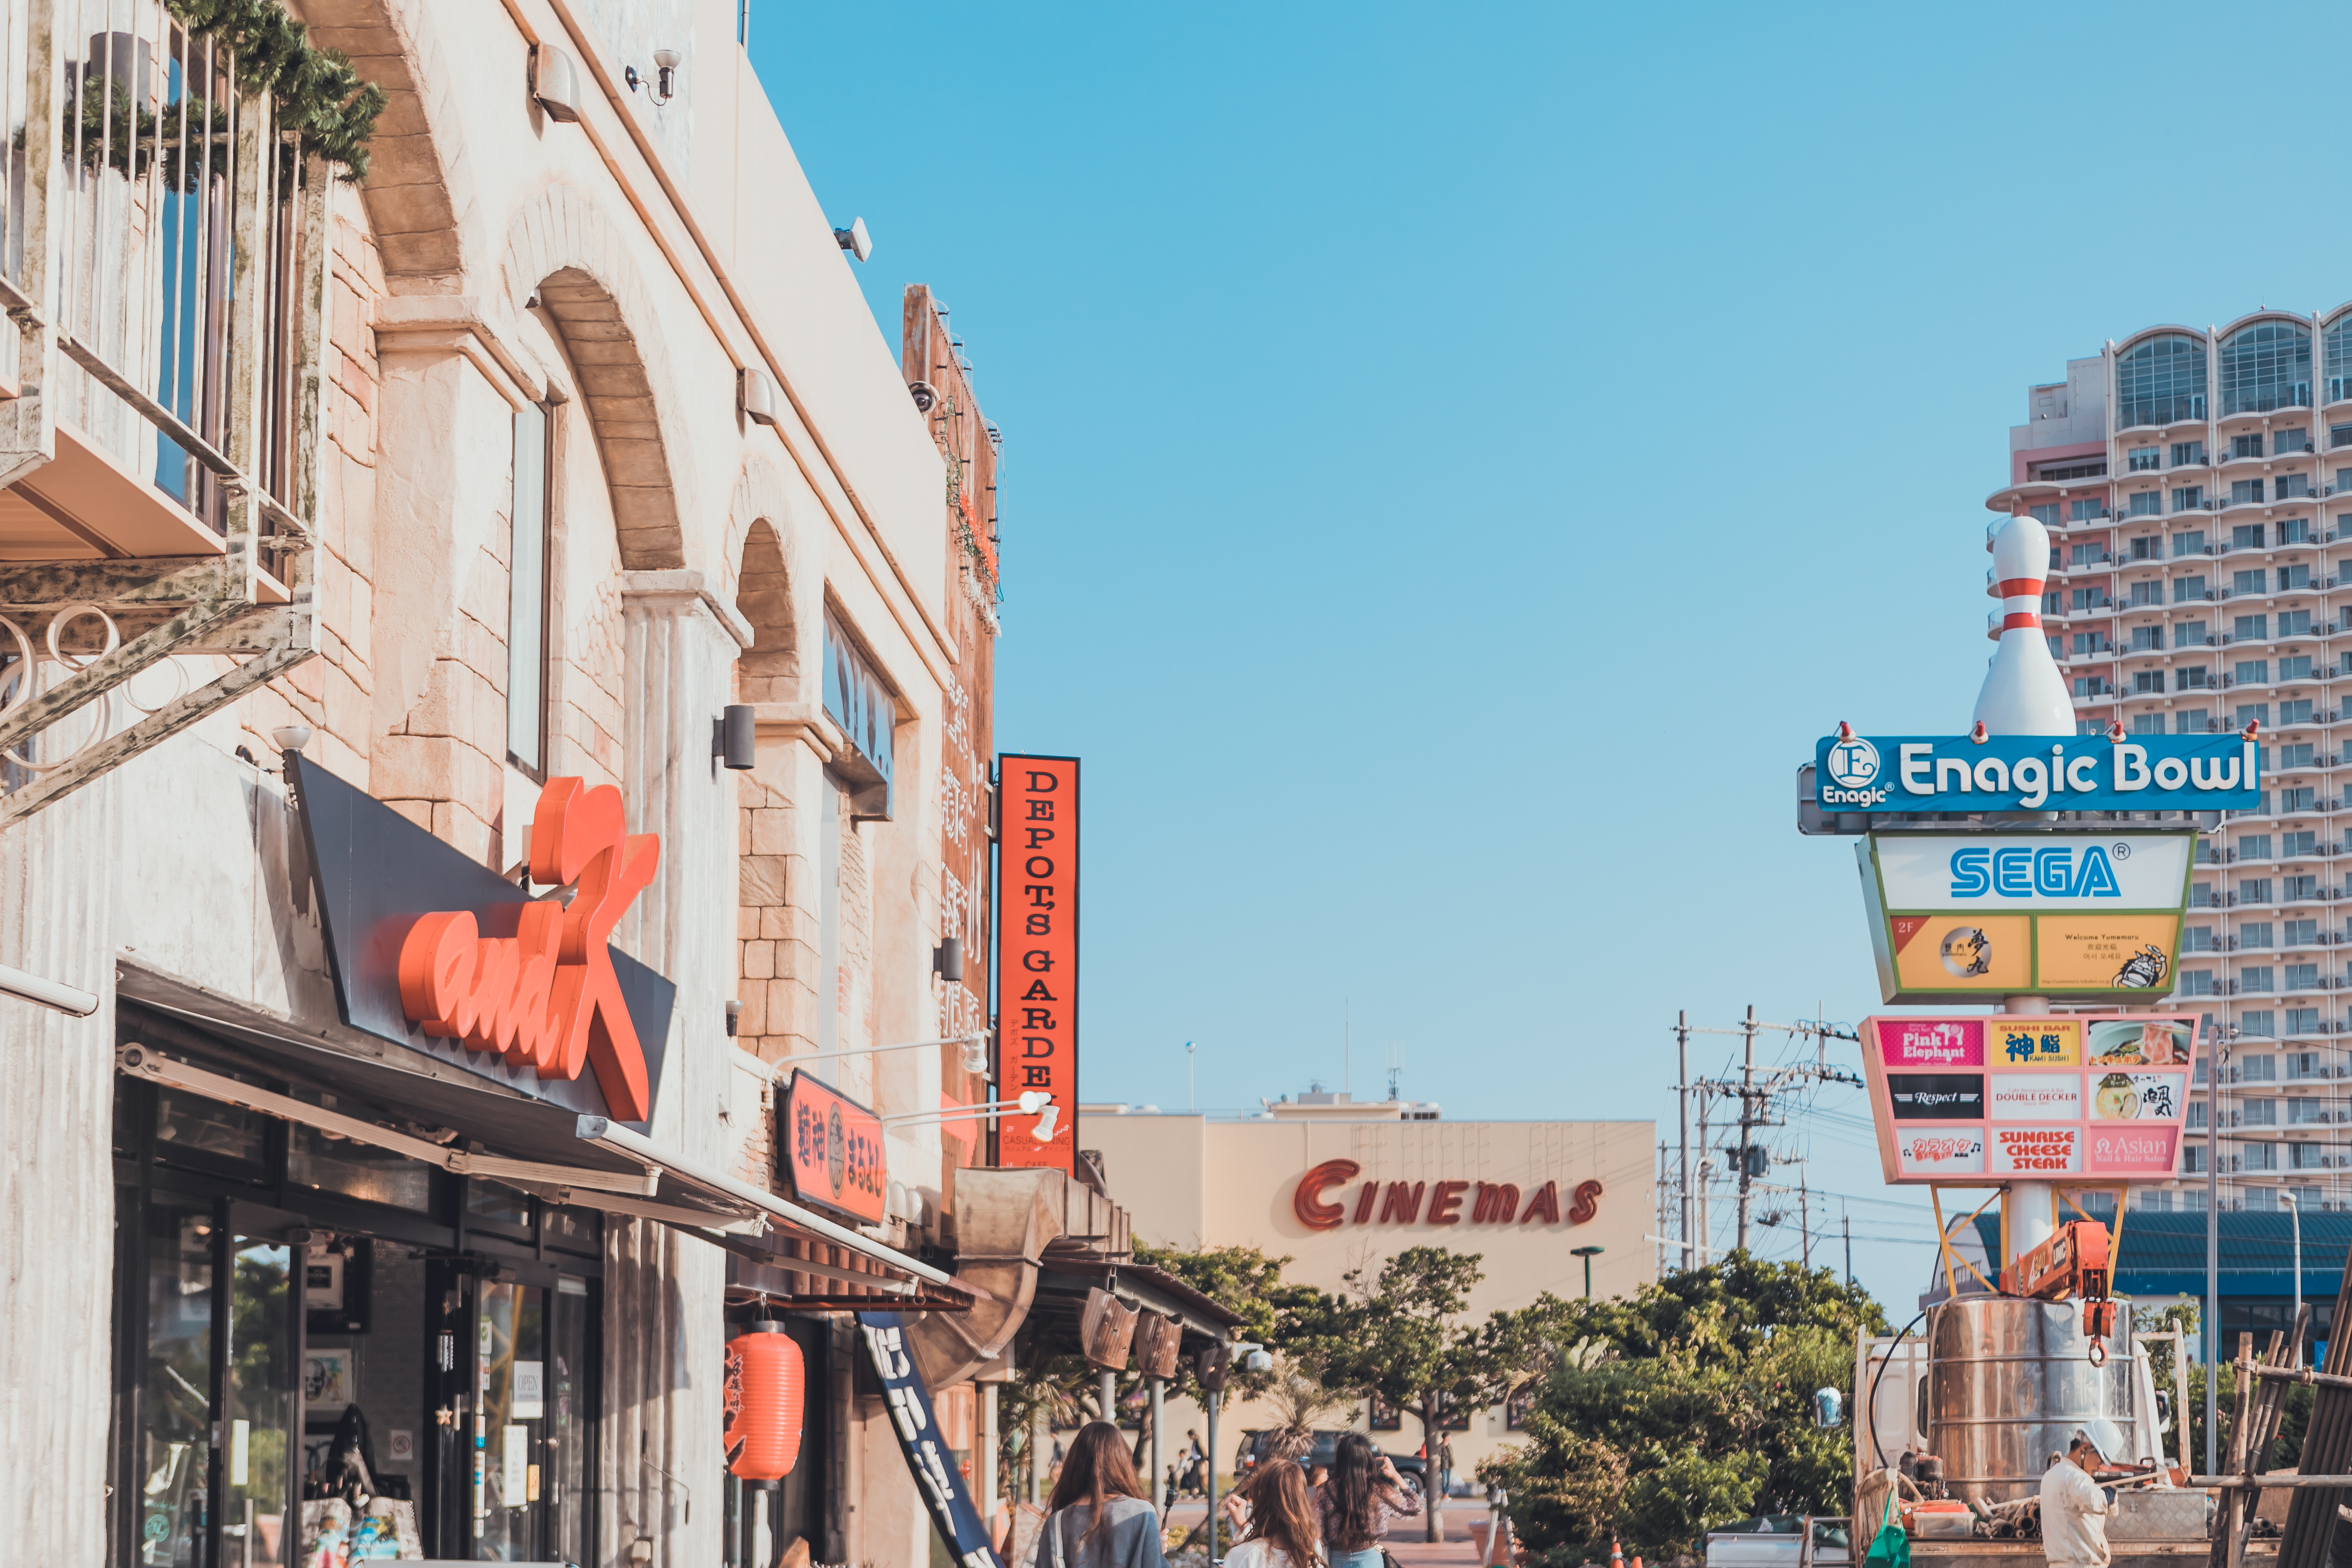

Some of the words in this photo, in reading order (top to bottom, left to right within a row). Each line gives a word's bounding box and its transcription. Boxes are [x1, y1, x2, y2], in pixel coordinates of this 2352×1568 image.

[1900, 743, 2098, 808] Enagic
[2114, 742, 2255, 791] Bowl
[1823, 785, 1886, 807] Enagic
[1951, 846, 2121, 897] SEGA
[1898, 922, 1913, 933] 2F
[1021, 950, 1057, 1116] GARDE
[1903, 1032, 1942, 1046] Pink
[1903, 1046, 1965, 1061] Elephant
[1010, 1056, 1019, 1091] ガーデン
[1915, 1092, 1957, 1106] Respect
[1004, 1135, 1039, 1144] CASUAL
[1913, 1138, 1971, 1152] カラオケ
[2000, 1131, 2074, 1143] SUNRISE
[2007, 1145, 2071, 1156] CHEESE
[2114, 1137, 2166, 1154] Asian
[847, 1127, 882, 1198] まるよし
[2013, 1158, 2067, 1169] STEAK
[1295, 1158, 1603, 1230] CINEMAS
[2053, 1241, 2066, 1266] UNIC
[518, 1375, 538, 1391] OPEN
